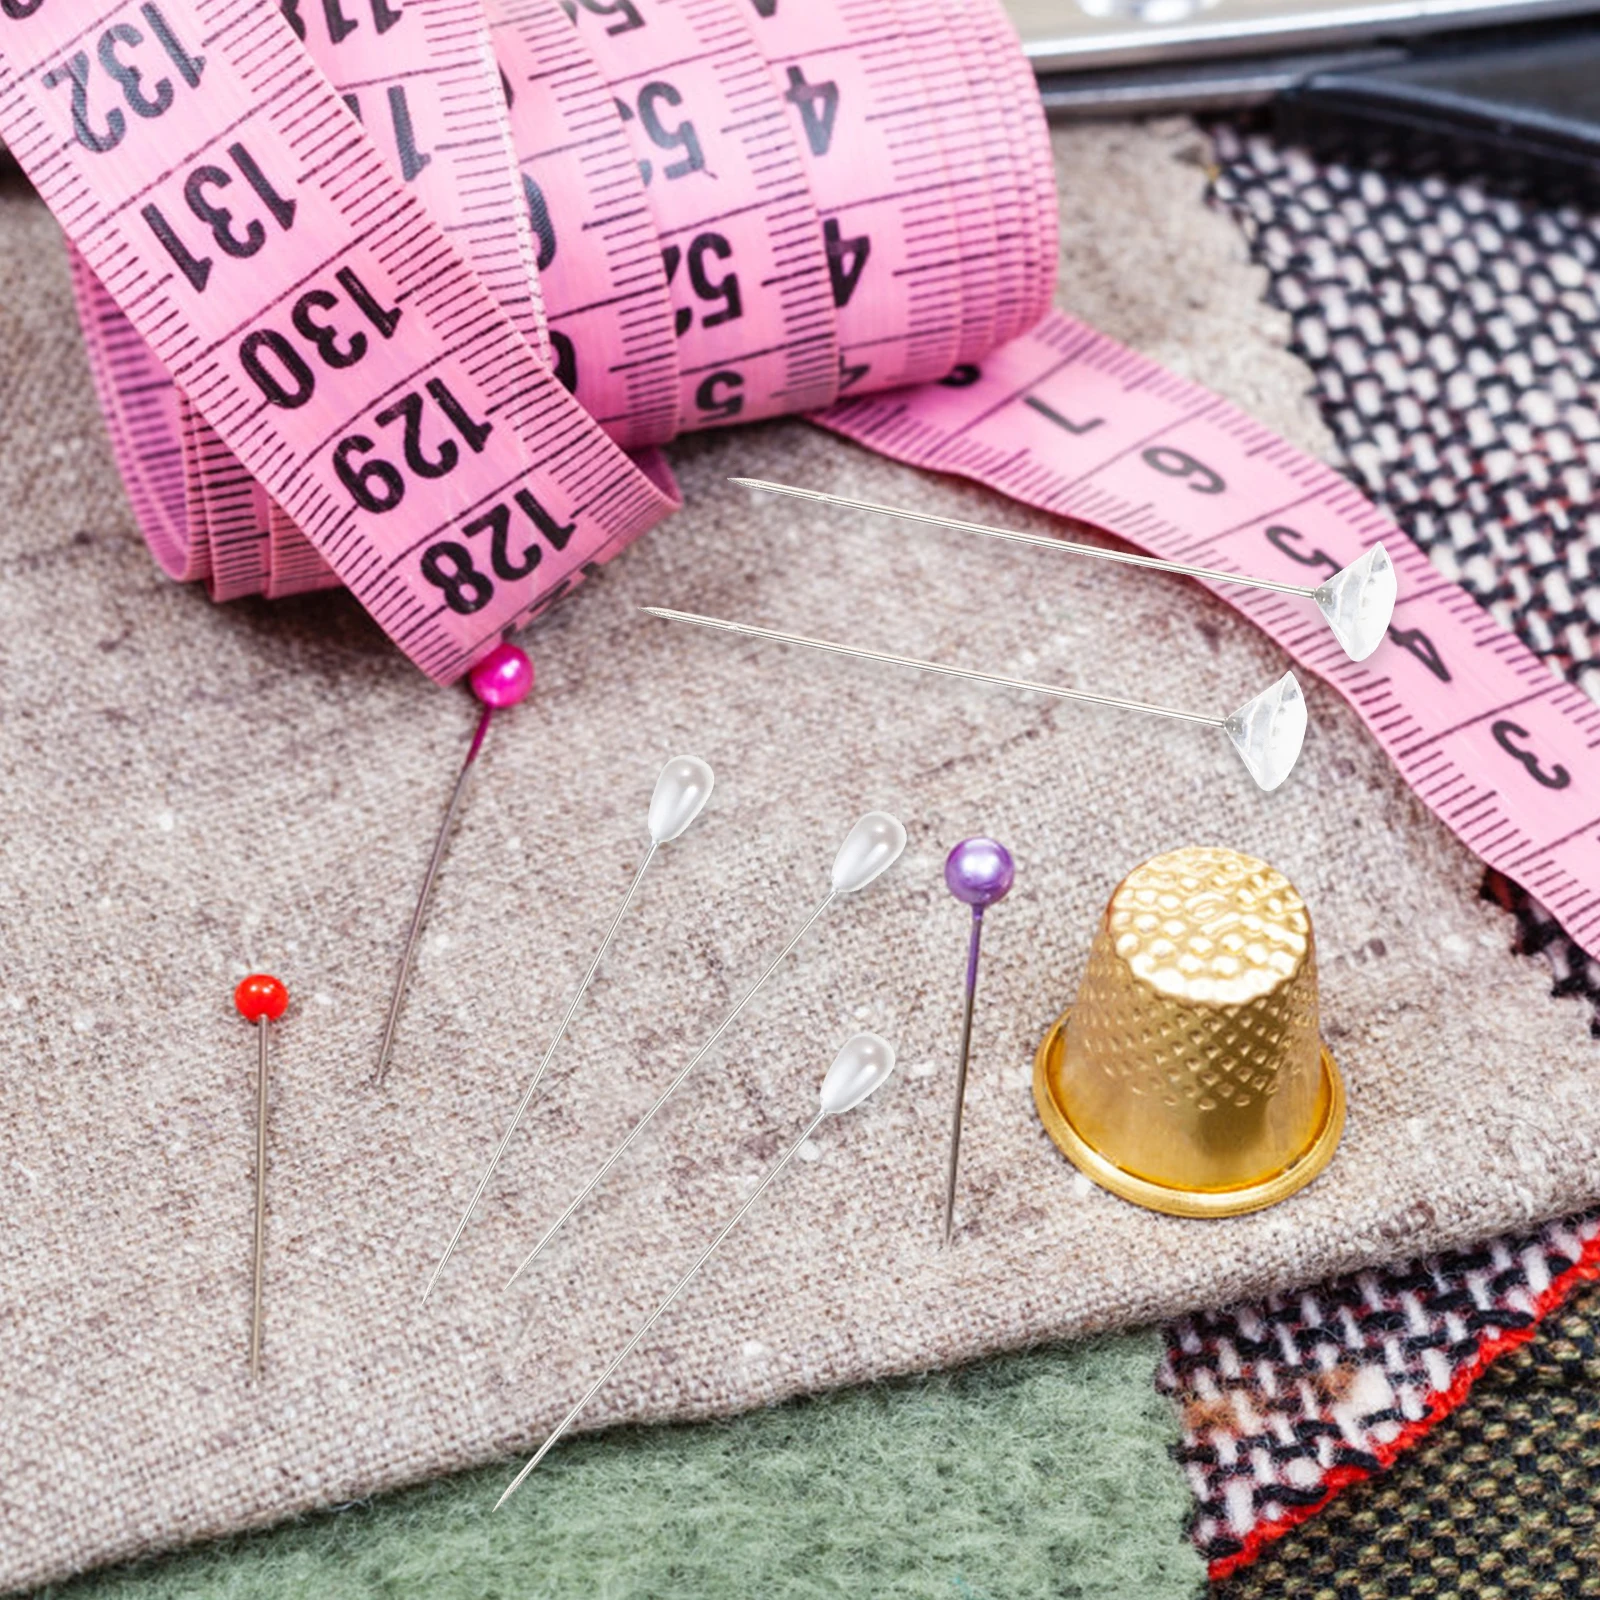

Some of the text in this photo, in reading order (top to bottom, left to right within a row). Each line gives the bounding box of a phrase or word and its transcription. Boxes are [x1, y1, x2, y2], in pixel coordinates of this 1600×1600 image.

[41, 3, 206, 153] 132
[783, 65, 840, 156] 4
[140, 142, 297, 293] 131
[239, 266, 403, 409] 130
[332, 378, 494, 514] 129
[1021, 396, 1106, 436] 7
[1141, 446, 1227, 495] 6
[420, 488, 577, 615] 128
[1265, 525, 1344, 582] 5
[1387, 624, 1453, 684] 4
[1491, 719, 1571, 790] 3
